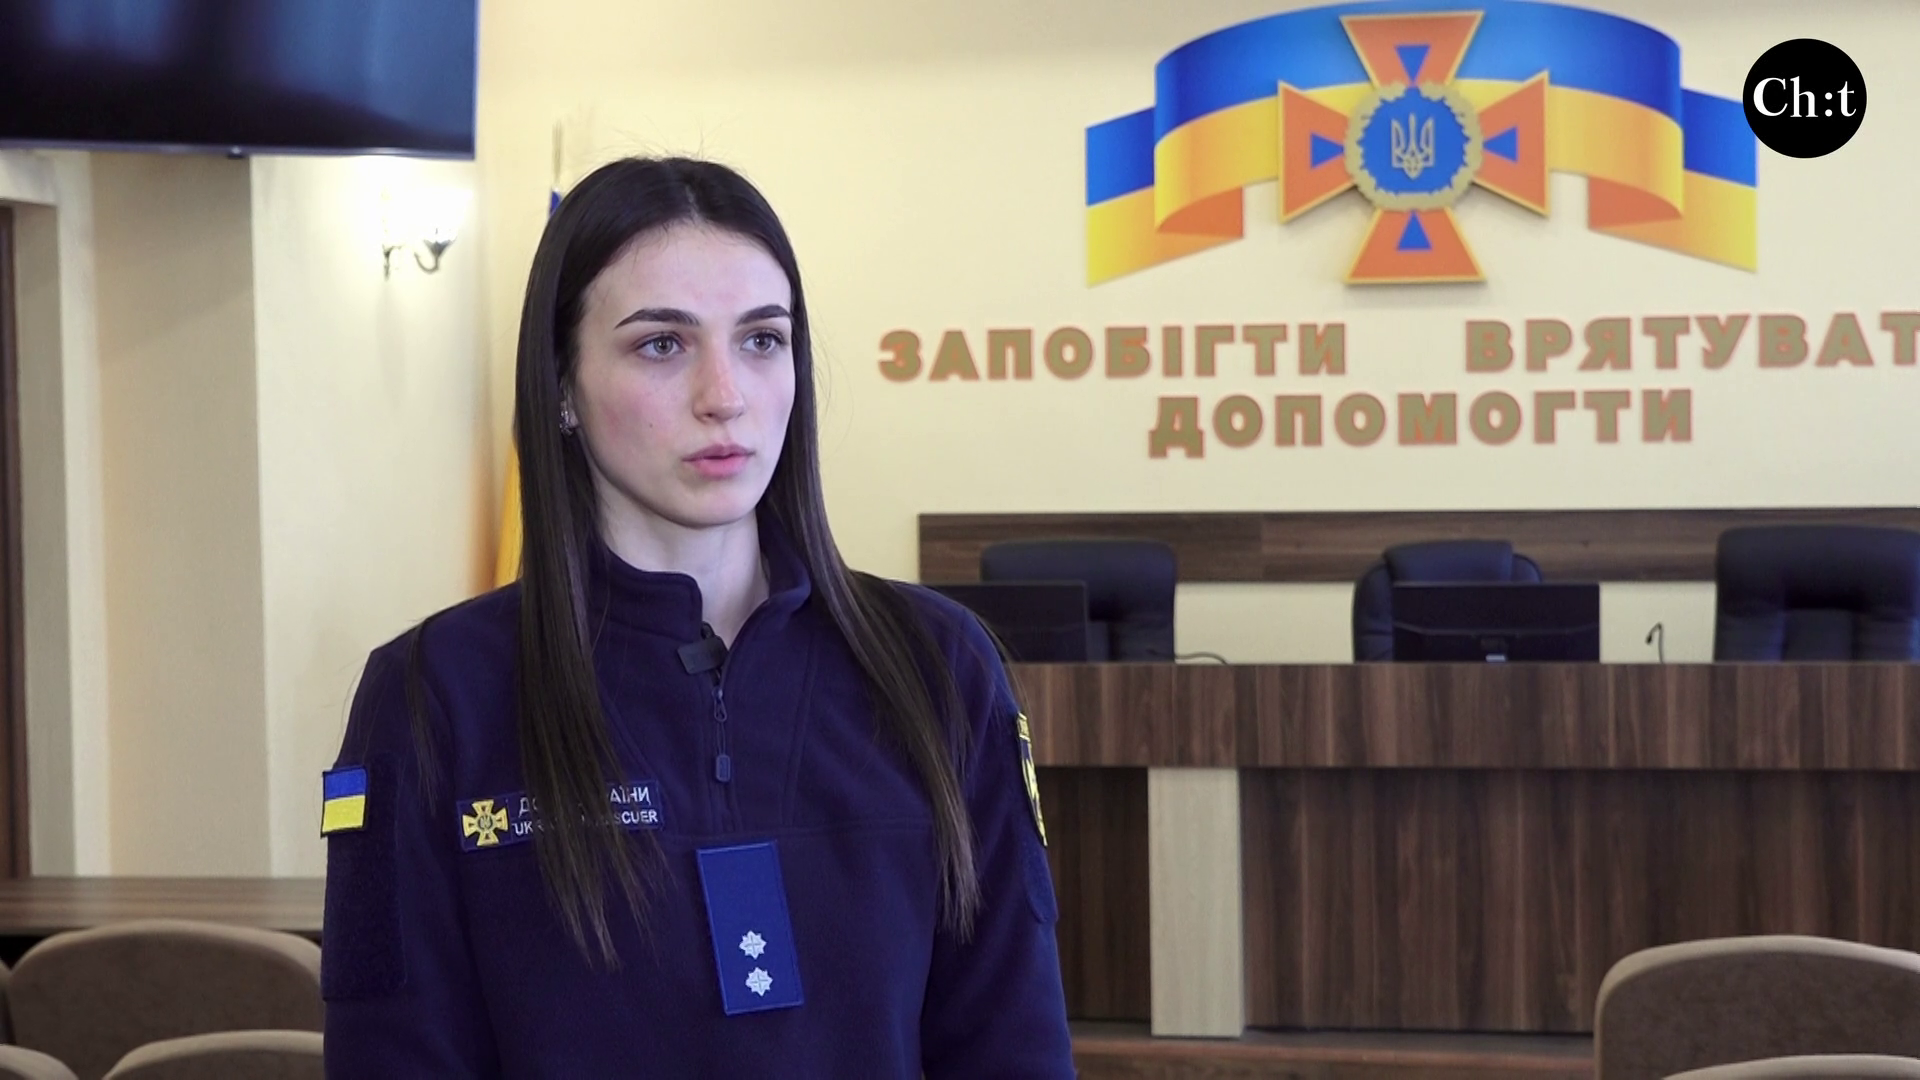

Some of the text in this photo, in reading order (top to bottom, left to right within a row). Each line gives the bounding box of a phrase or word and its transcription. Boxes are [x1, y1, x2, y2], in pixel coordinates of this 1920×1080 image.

[878, 311, 1920, 383] ЗАПОБІГТИ ВРЯТУВАТ
[1148, 388, 1693, 459] ДОПОМОГТИ
